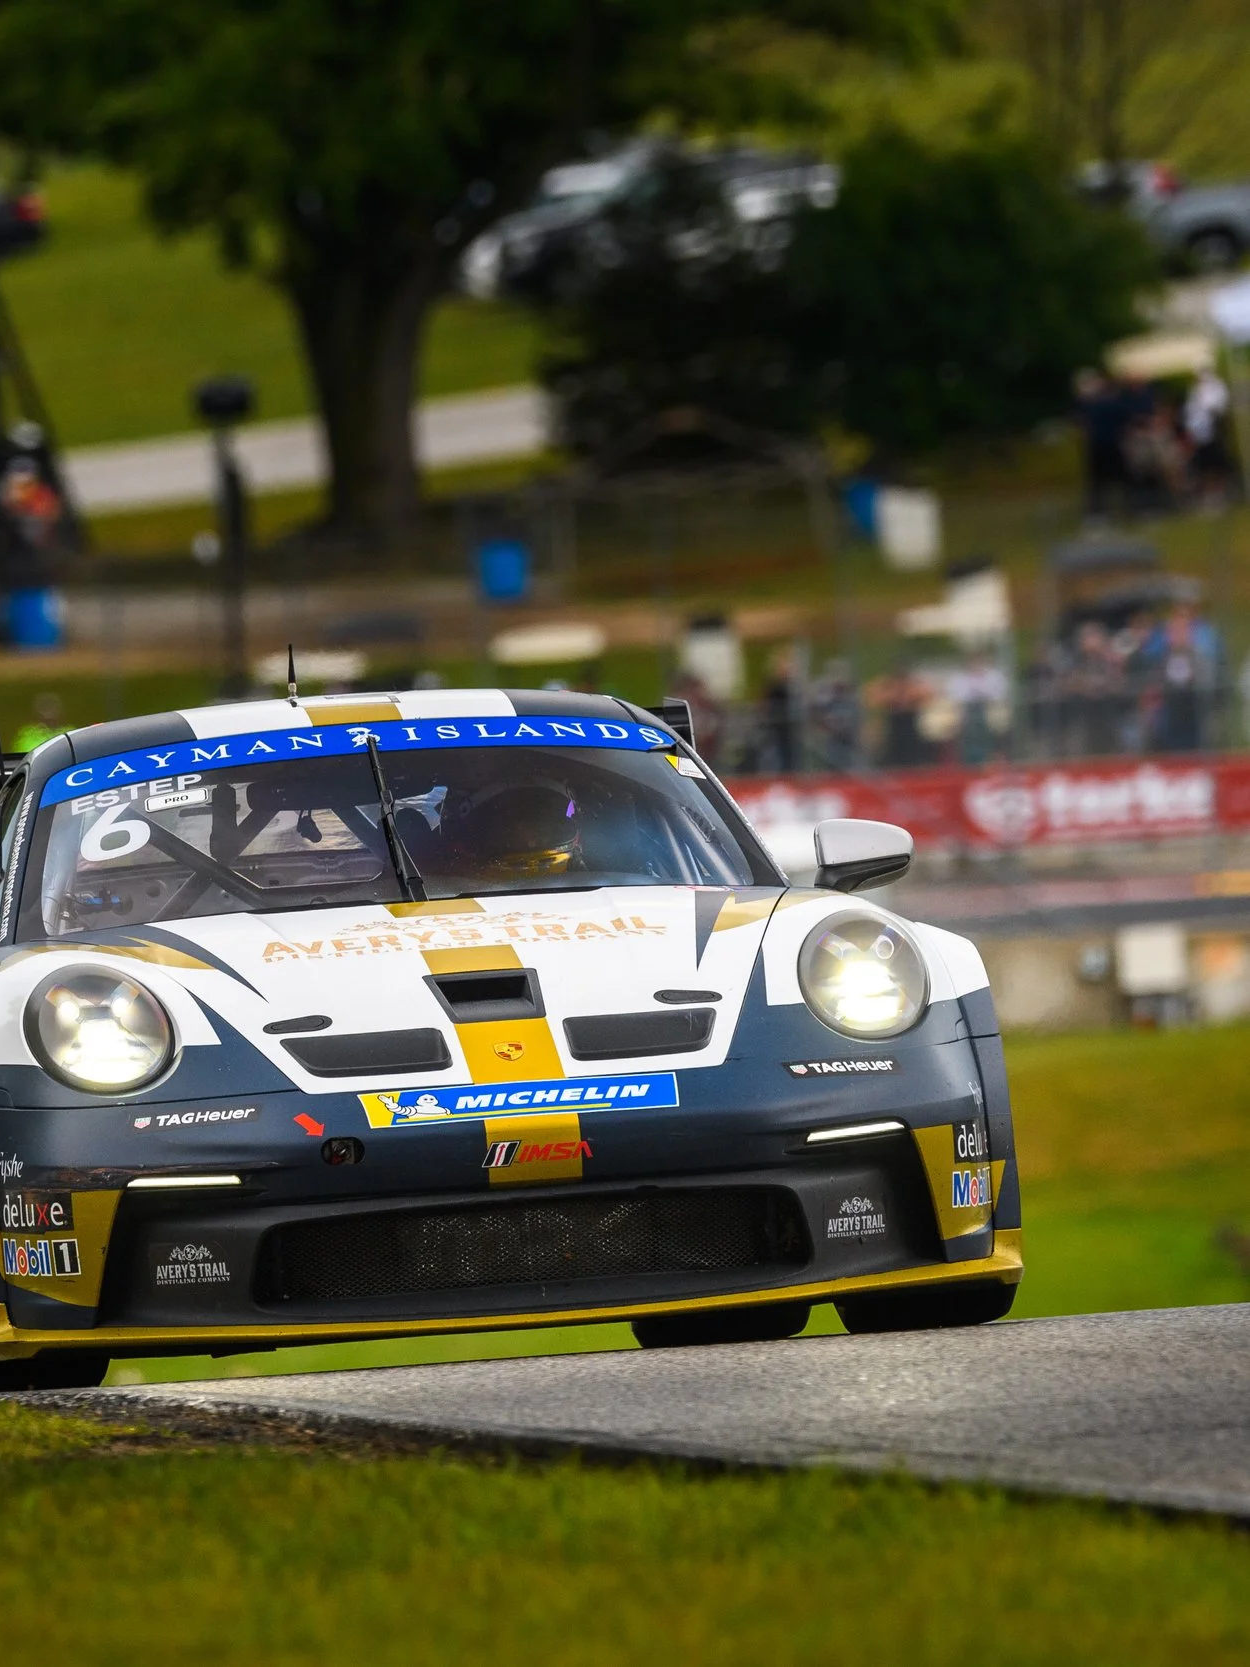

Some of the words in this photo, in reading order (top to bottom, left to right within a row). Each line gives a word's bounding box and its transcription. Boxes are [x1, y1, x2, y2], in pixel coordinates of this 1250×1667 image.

[65, 732, 323, 787] CAYMAN
[401, 722, 664, 745] ISLANDS
[70, 773, 203, 816] ESTEP
[164, 794, 189, 804] PRO
[80, 801, 151, 862] 6
[492, 915, 667, 937] TRAIL
[455, 1083, 650, 1110] MICHELIN
[517, 1141, 593, 1163] IMSA
[3, 1195, 65, 1228] deluxe
[827, 1214, 860, 1233] AVERY'S
[861, 1213, 886, 1230] TRAIL
[827, 1231, 860, 1239] DISTILLING
[860, 1228, 885, 1236] COMPANY
[2, 1238, 52, 1277] Mobil
[156, 1262, 197, 1280] AVERY'S
[197, 1262, 230, 1277] TRAIL
[156, 1278, 196, 1286] DISTILLING
